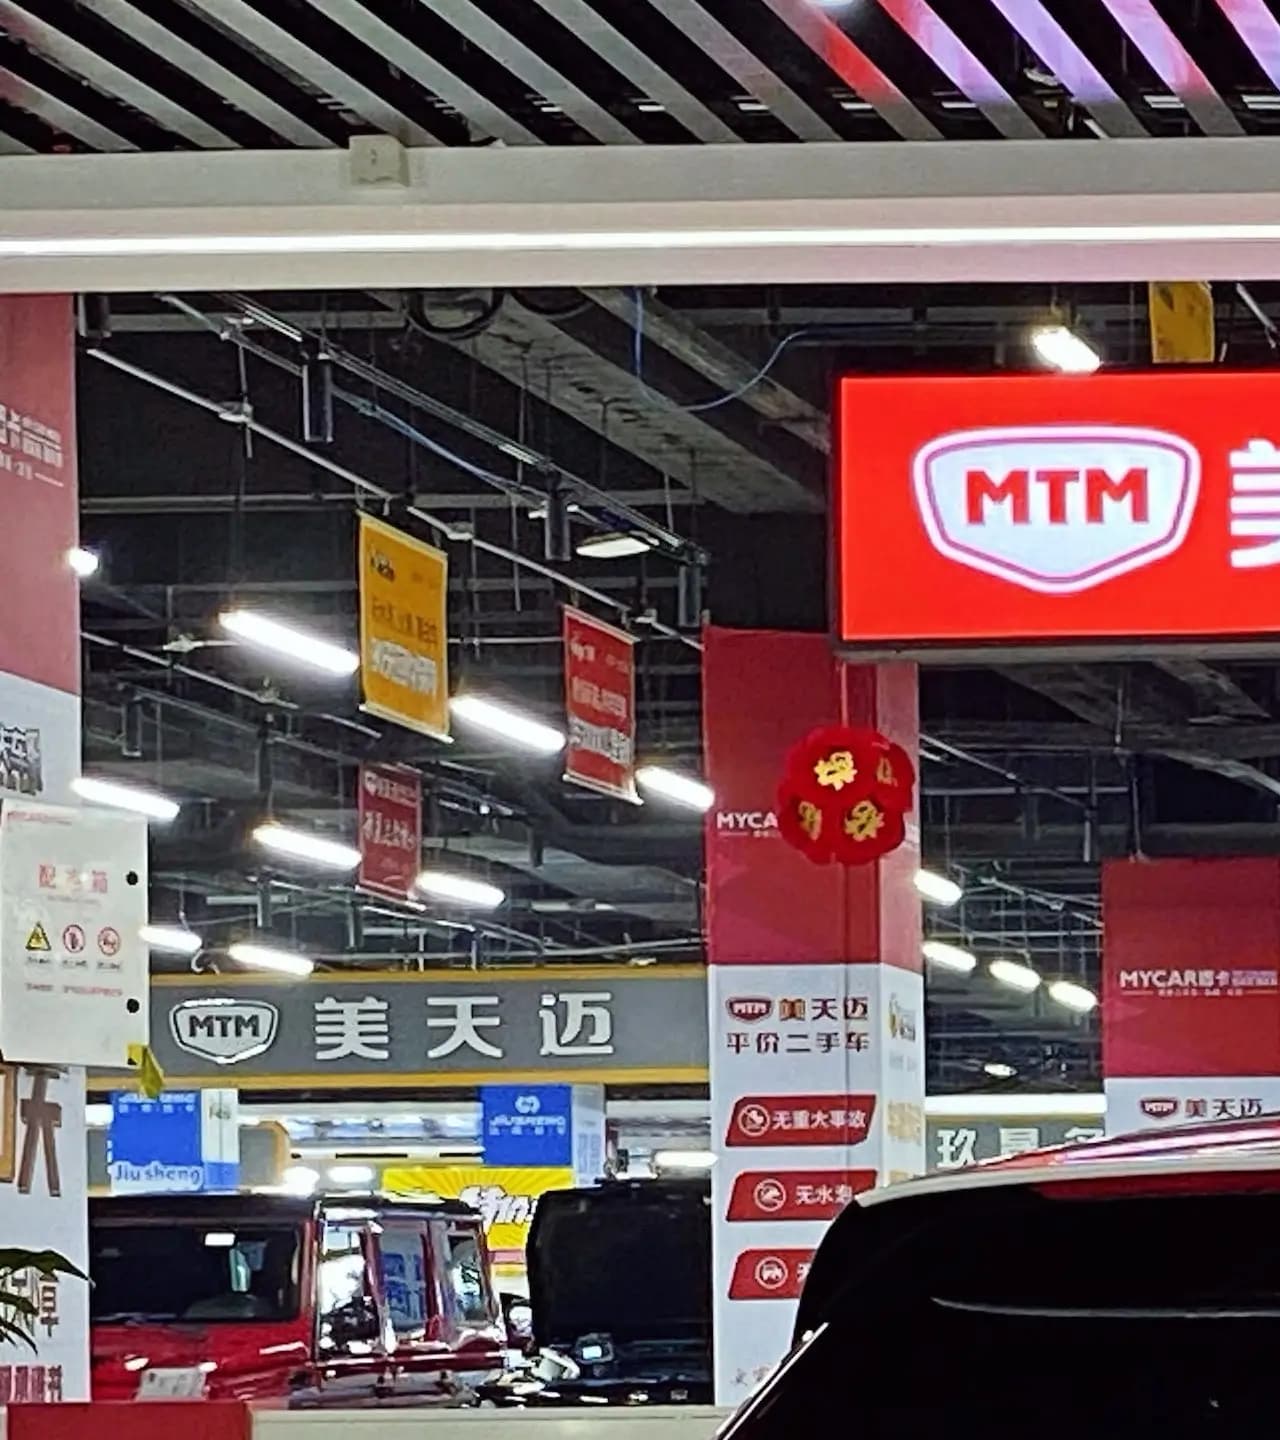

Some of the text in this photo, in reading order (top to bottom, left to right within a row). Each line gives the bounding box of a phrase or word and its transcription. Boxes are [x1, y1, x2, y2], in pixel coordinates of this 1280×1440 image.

[964, 467, 1148, 525] MTM
[716, 812, 778, 829] MYCA
[188, 1014, 261, 1040] MTM
[313, 992, 613, 1060] 美天迈
[726, 1032, 870, 1055] 平价二手车
[771, 1109, 867, 1131] 无重大事故
